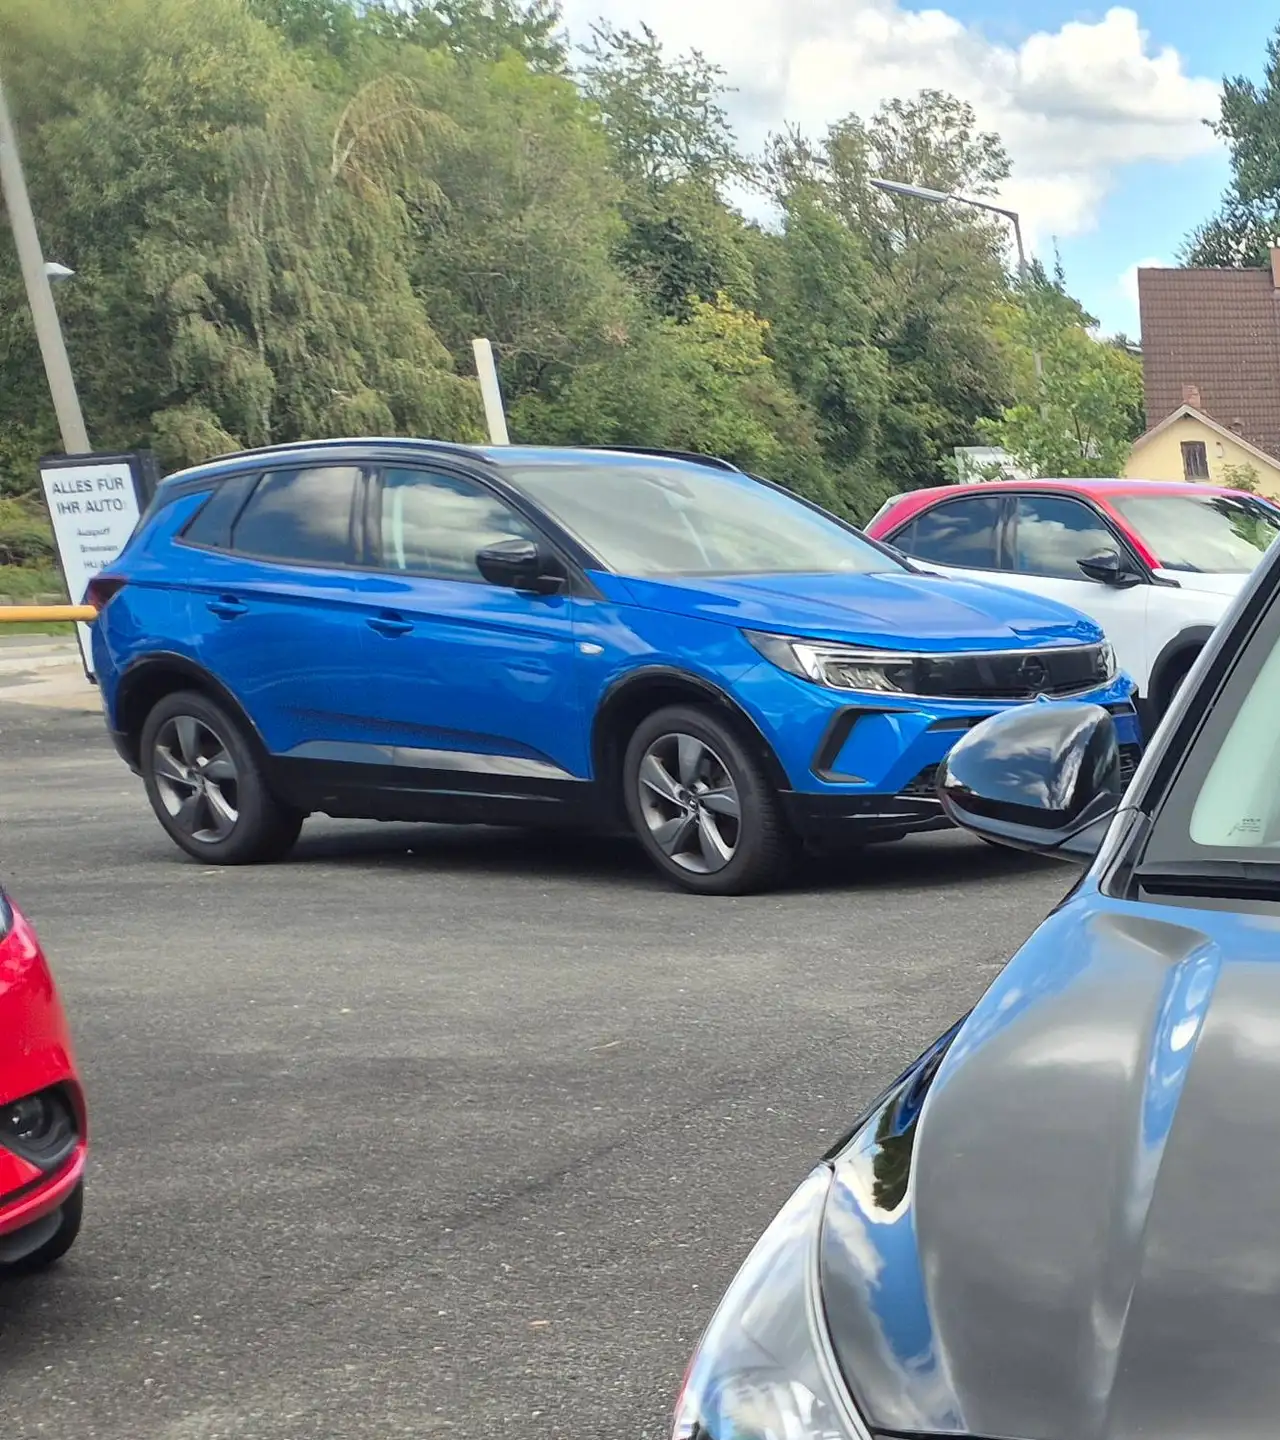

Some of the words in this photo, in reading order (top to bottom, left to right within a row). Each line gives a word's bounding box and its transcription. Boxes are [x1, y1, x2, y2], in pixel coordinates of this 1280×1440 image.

[52, 480, 93, 495] ALLES
[97, 474, 125, 491] FÜR
[56, 501, 81, 515] IHR
[86, 498, 123, 513] AUTO
